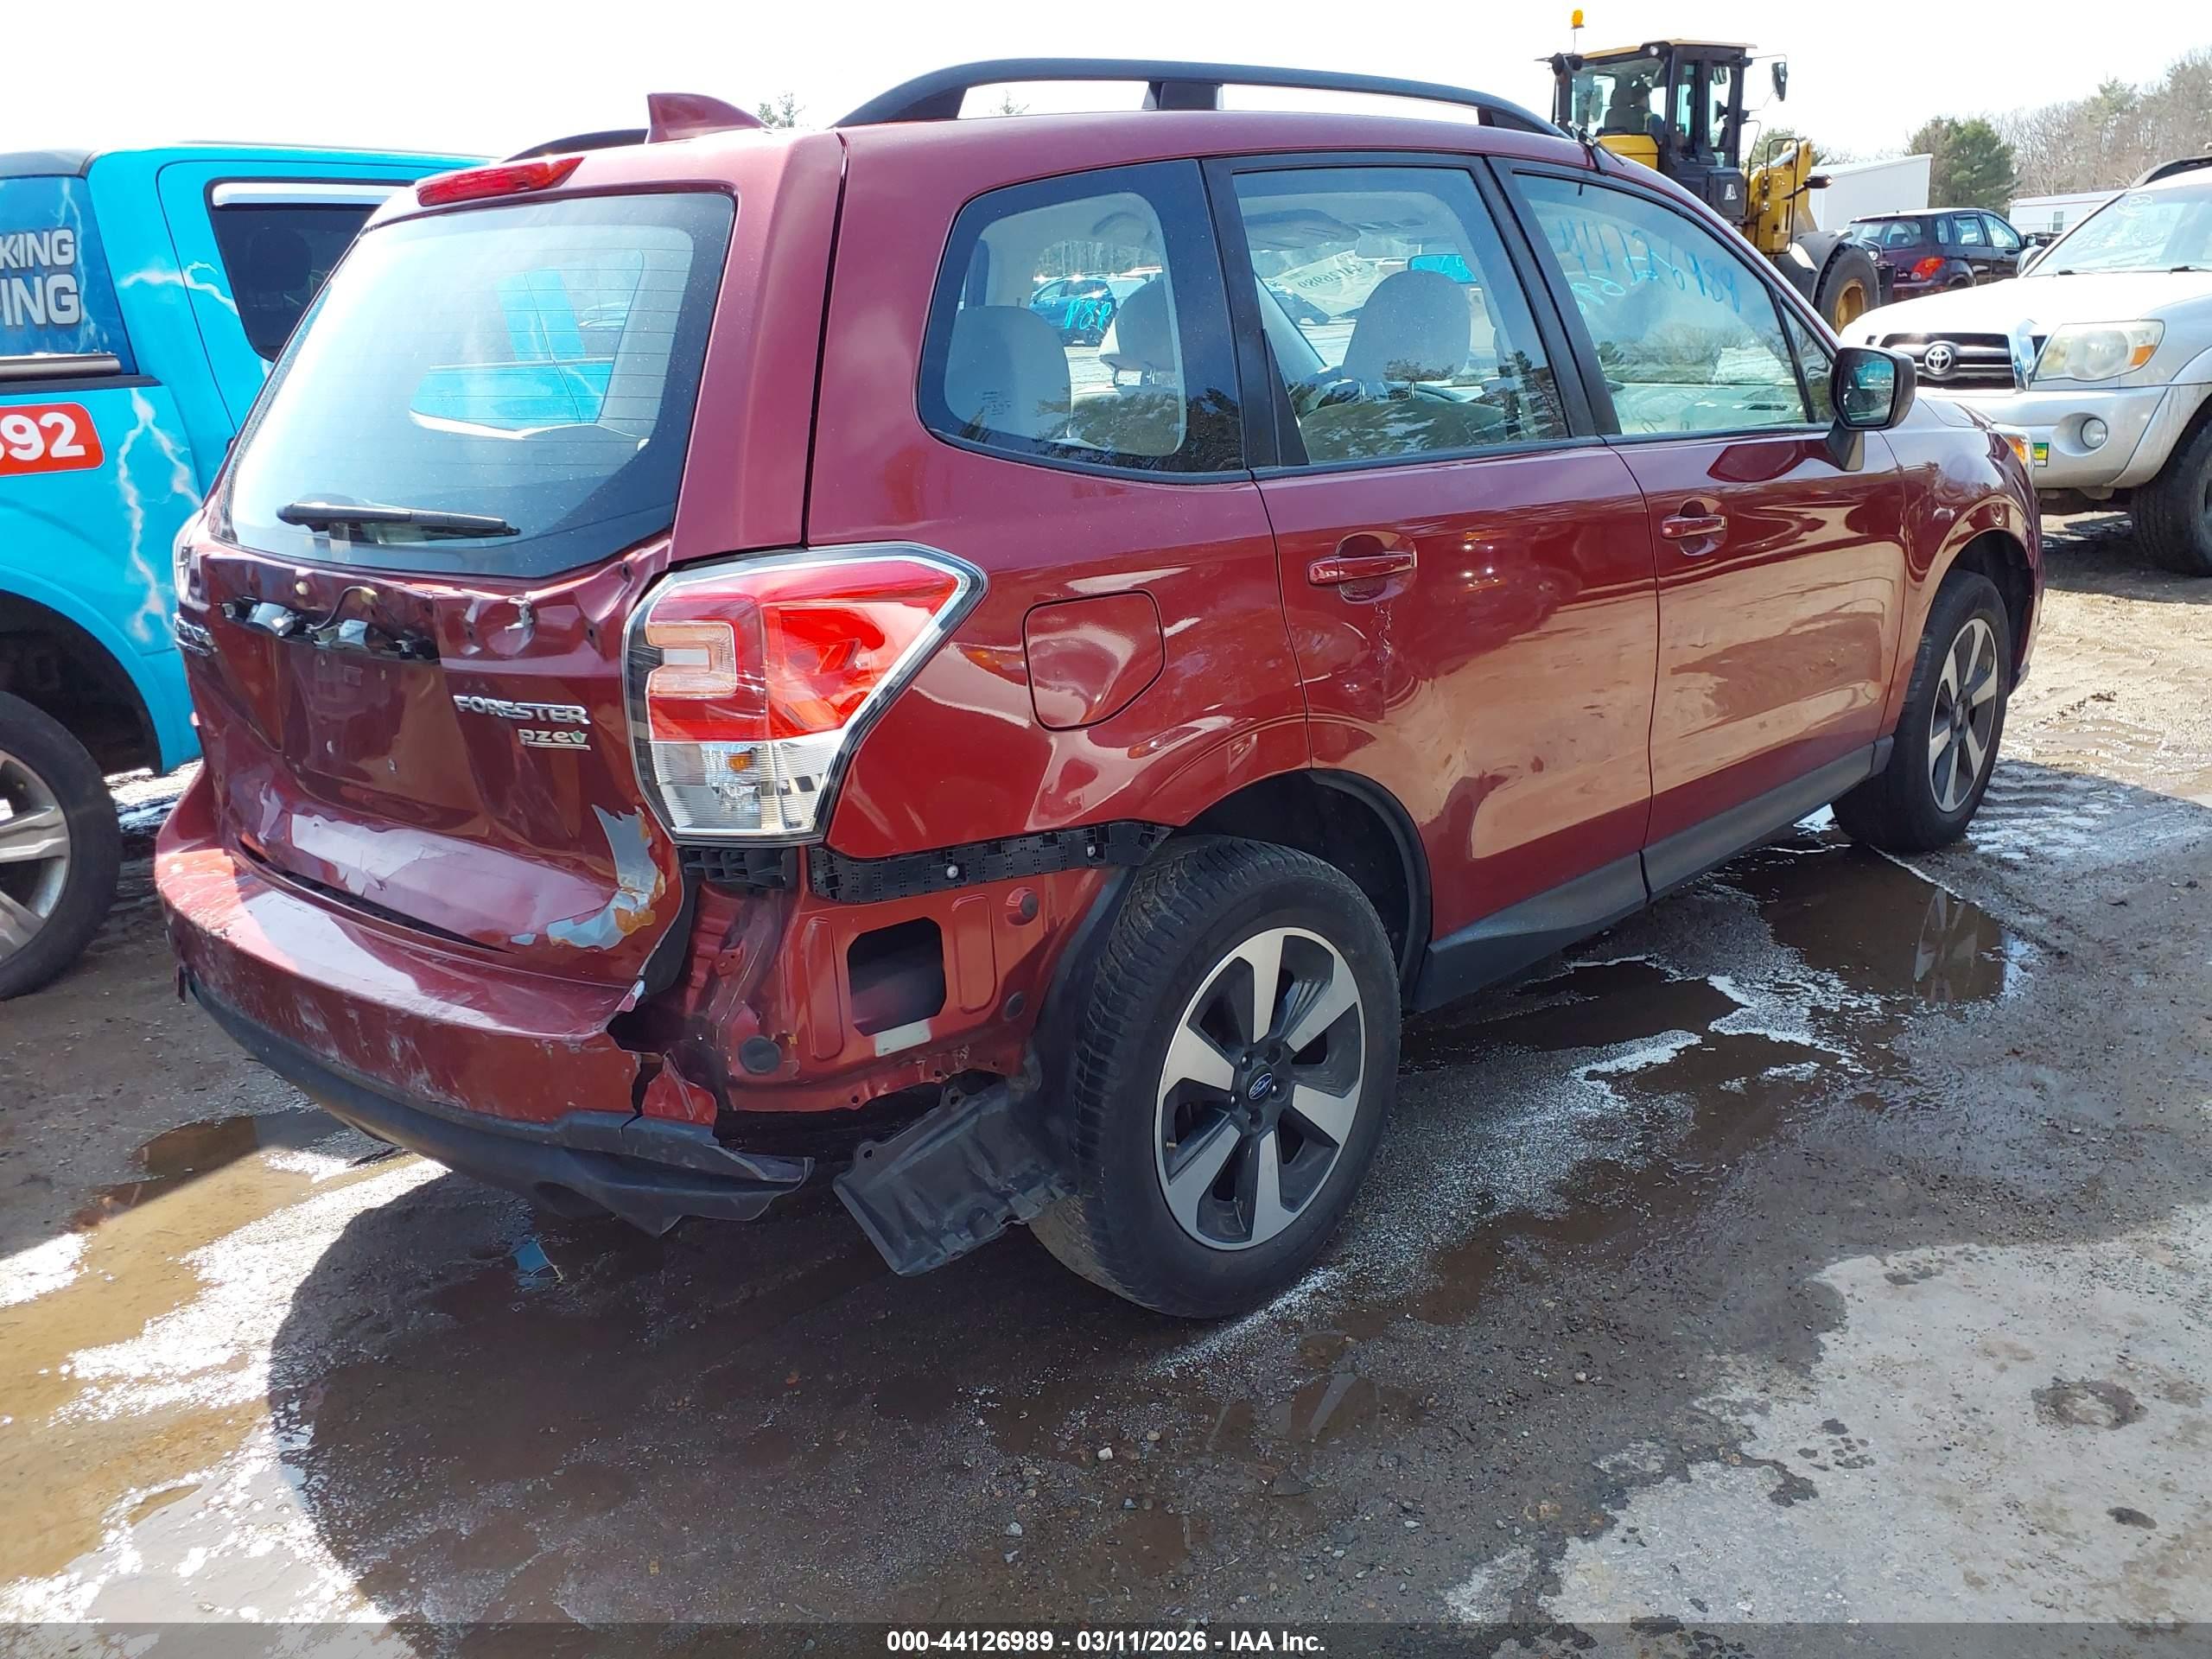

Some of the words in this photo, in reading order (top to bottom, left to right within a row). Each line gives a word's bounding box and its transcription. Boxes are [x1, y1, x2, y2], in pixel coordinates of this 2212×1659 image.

[0, 228, 75, 269] KING
[0, 273, 80, 326] ING
[0, 411, 86, 461] 92
[453, 695, 592, 725] FORESTER
